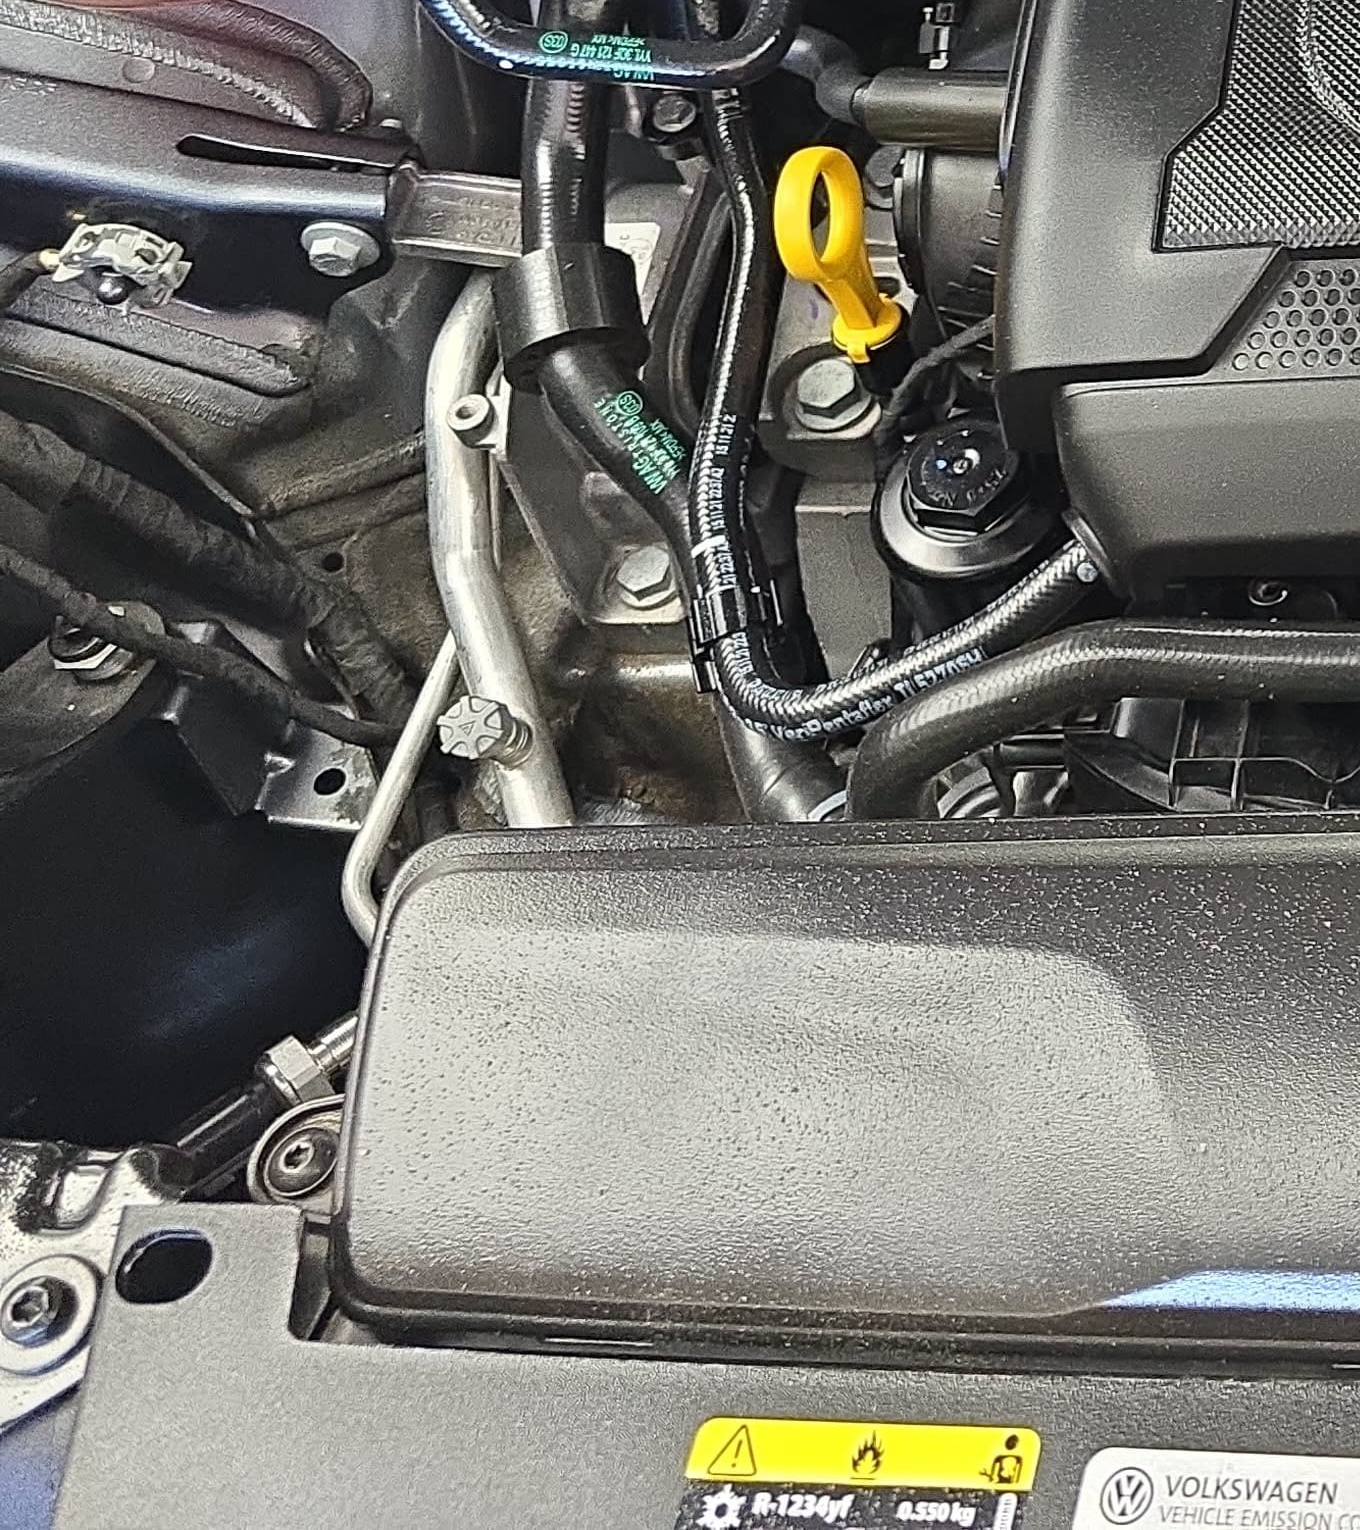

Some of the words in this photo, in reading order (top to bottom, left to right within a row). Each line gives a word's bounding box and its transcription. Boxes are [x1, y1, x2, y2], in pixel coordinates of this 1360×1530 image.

[1165, 1475, 1338, 1506] VOLKSWAGEN
[752, 1492, 856, 1522] R-1234yf
[896, 1500, 949, 1522] 0.550
[951, 1504, 976, 1527] kg
[1160, 1505, 1235, 1526] VEHICLE
[1239, 1508, 1333, 1530] EMISSION
